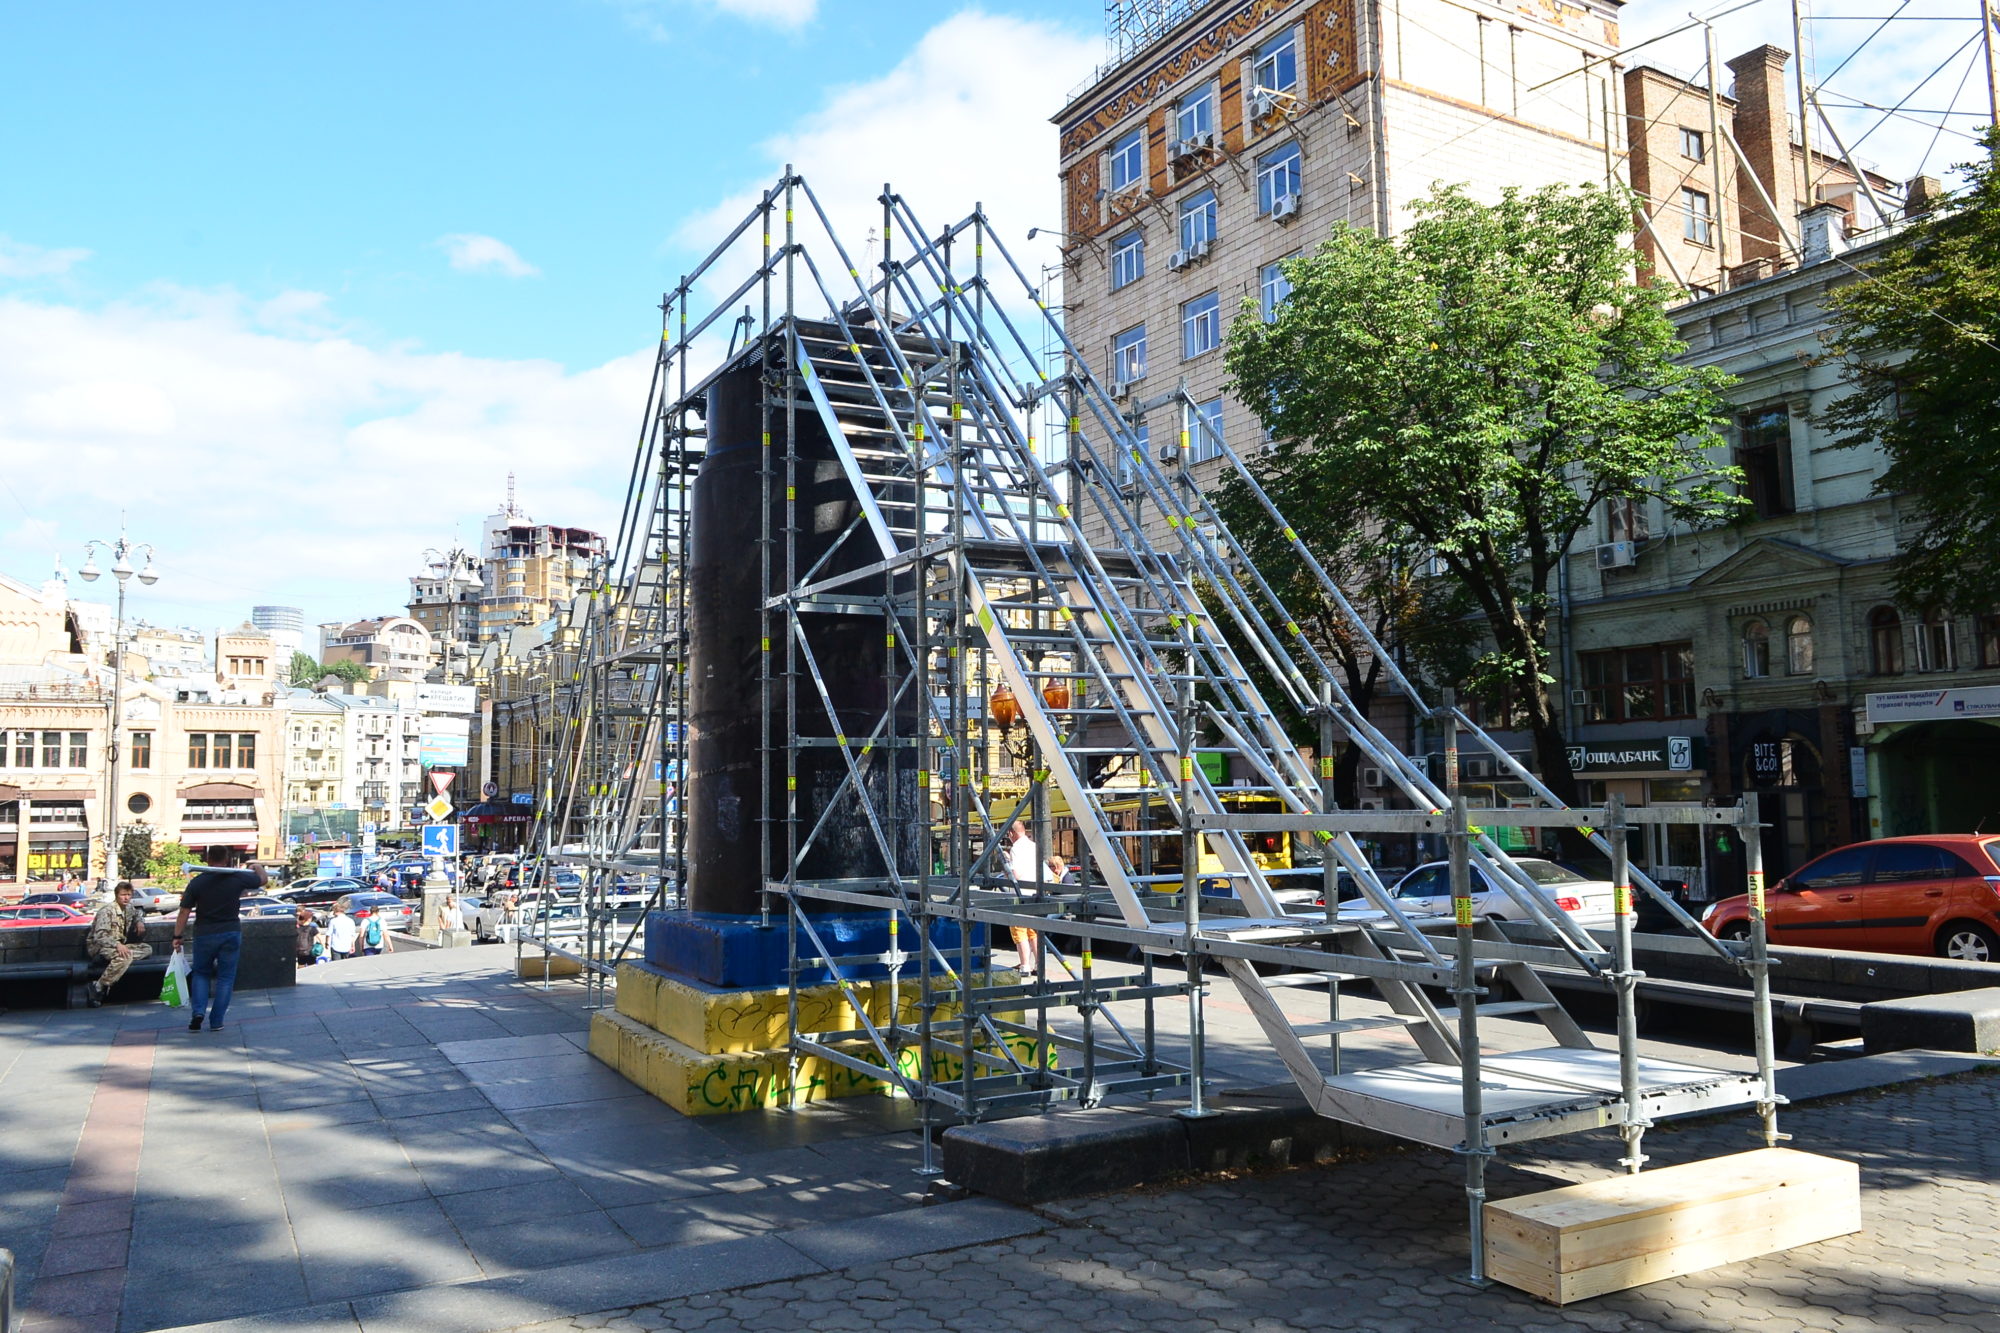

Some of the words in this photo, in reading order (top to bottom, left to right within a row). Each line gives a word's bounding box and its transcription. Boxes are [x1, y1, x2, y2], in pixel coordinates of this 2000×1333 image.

[1587, 750, 1662, 764] ОЩАДБАНК
[1754, 743, 1775, 757] BITE
[1755, 758, 1777, 771] &GO!
[28, 853, 82, 868] BILLA
[1749, 875, 1757, 890] UP
